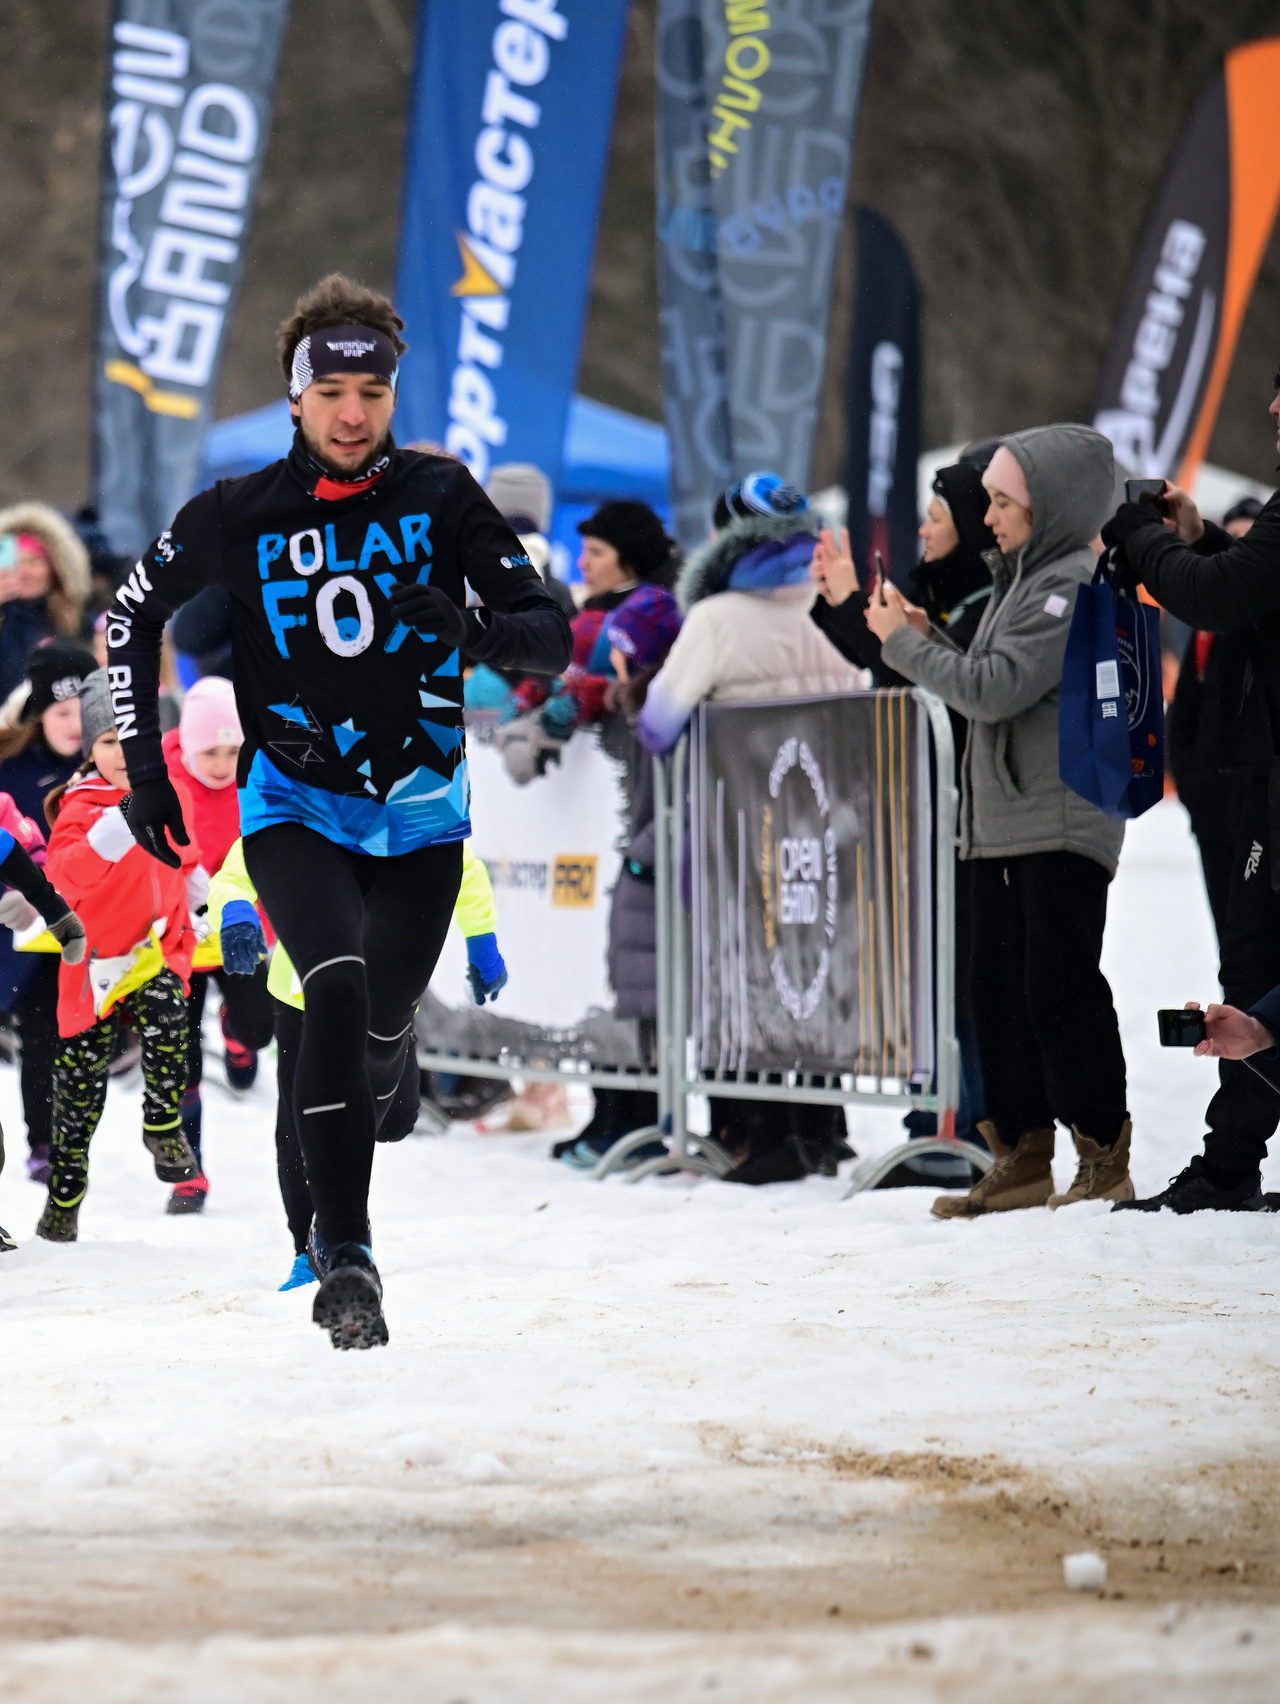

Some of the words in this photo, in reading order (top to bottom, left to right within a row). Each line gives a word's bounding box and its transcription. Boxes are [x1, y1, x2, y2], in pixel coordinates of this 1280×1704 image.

[445, 0, 570, 482] ортмастер
[257, 512, 434, 579] POLAR
[108, 665, 139, 741] RUN
